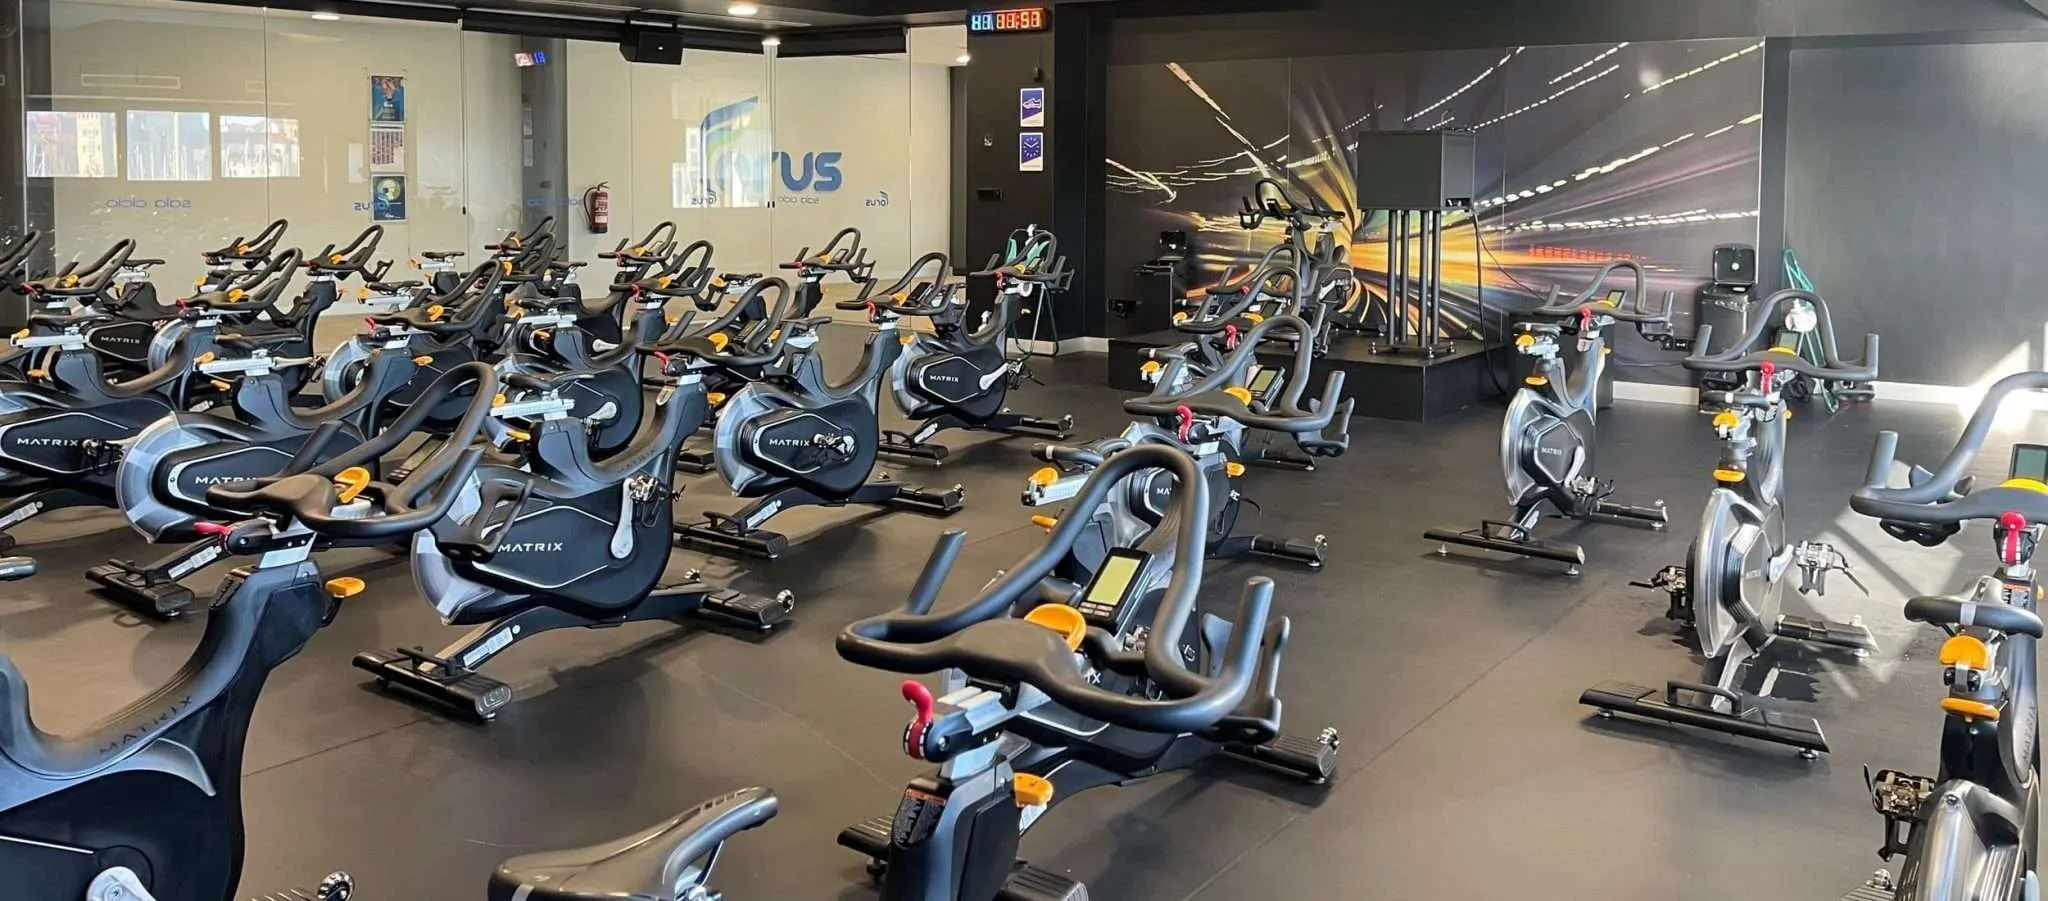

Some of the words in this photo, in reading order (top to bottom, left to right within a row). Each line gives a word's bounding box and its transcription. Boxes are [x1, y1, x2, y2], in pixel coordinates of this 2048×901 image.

[101, 336, 141, 344] MATRIX
[17, 438, 79, 447] MATRIX
[769, 438, 810, 447] MATRIX
[498, 542, 563, 553] MATRIX
